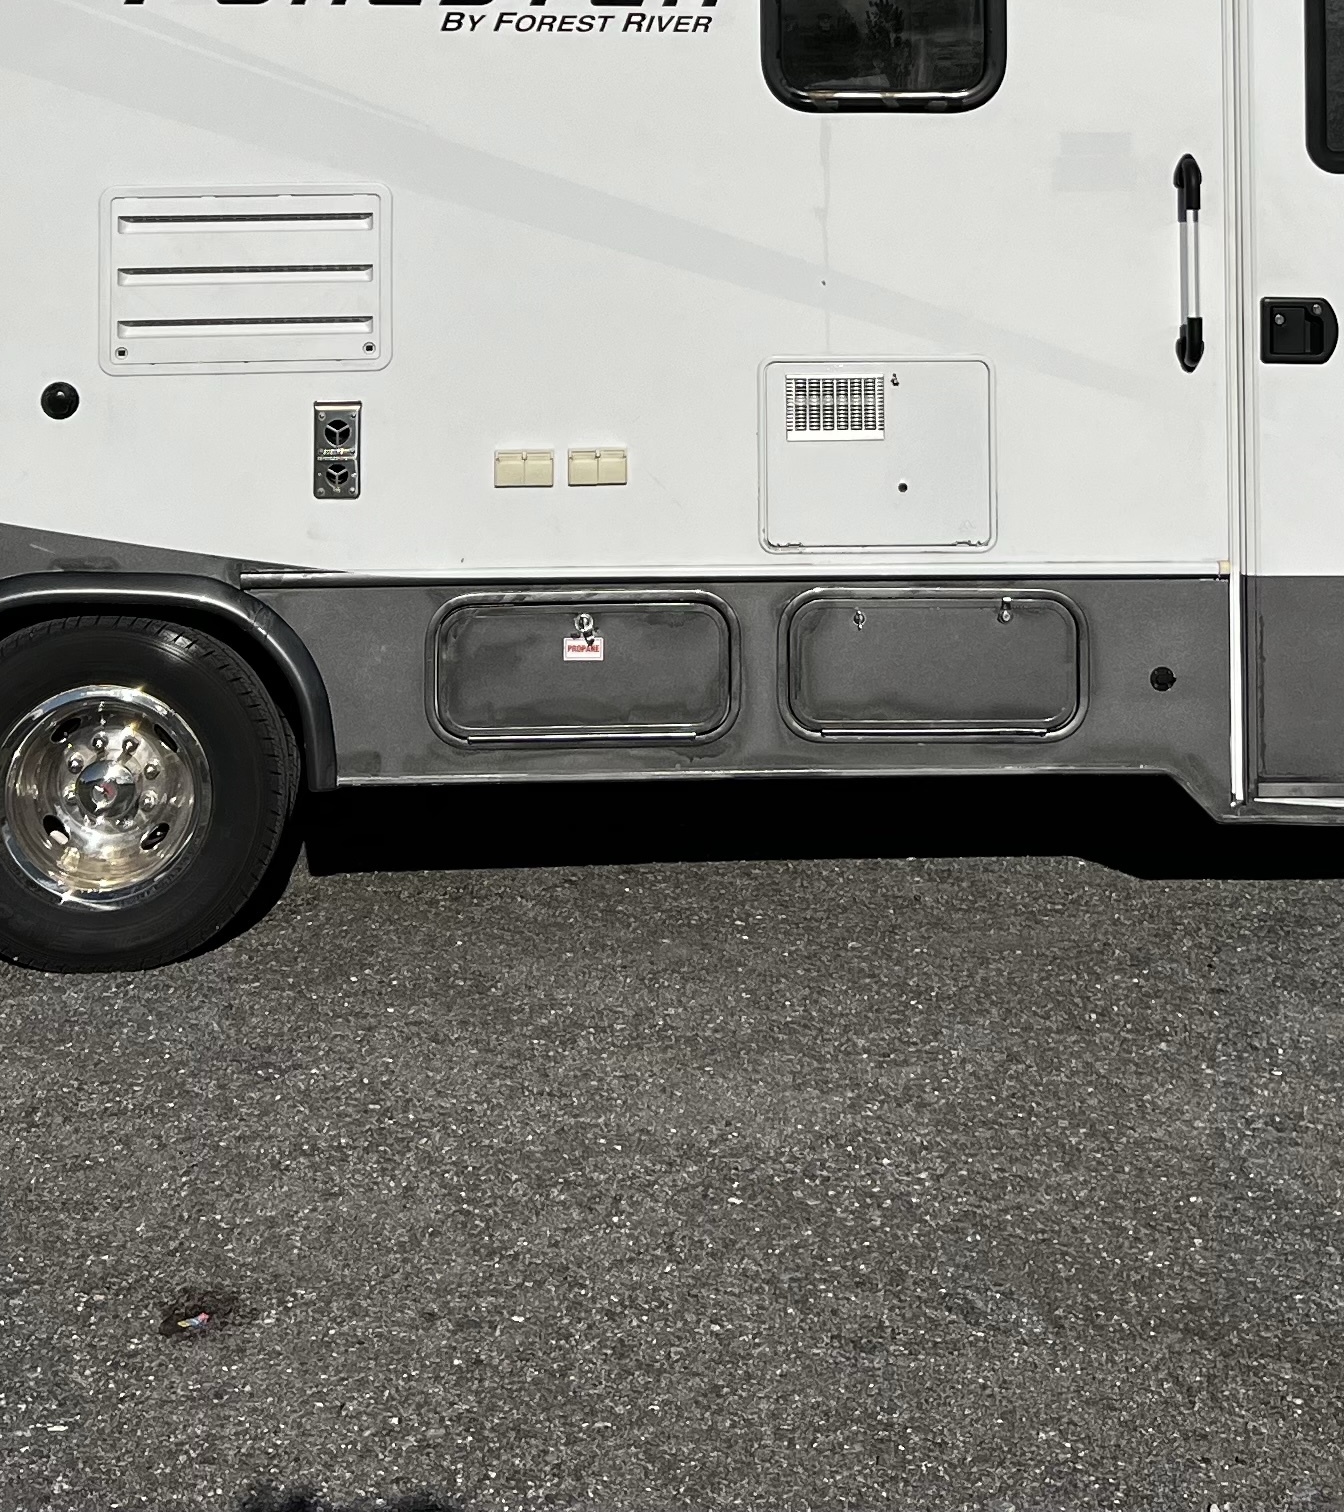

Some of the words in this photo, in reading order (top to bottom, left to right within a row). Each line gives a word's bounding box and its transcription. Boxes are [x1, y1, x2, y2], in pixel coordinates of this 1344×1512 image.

[441, 11, 485, 32] BY
[494, 11, 615, 32] FOREST
[621, 10, 712, 33] RIVER
[567, 644, 600, 653] PROPANE
